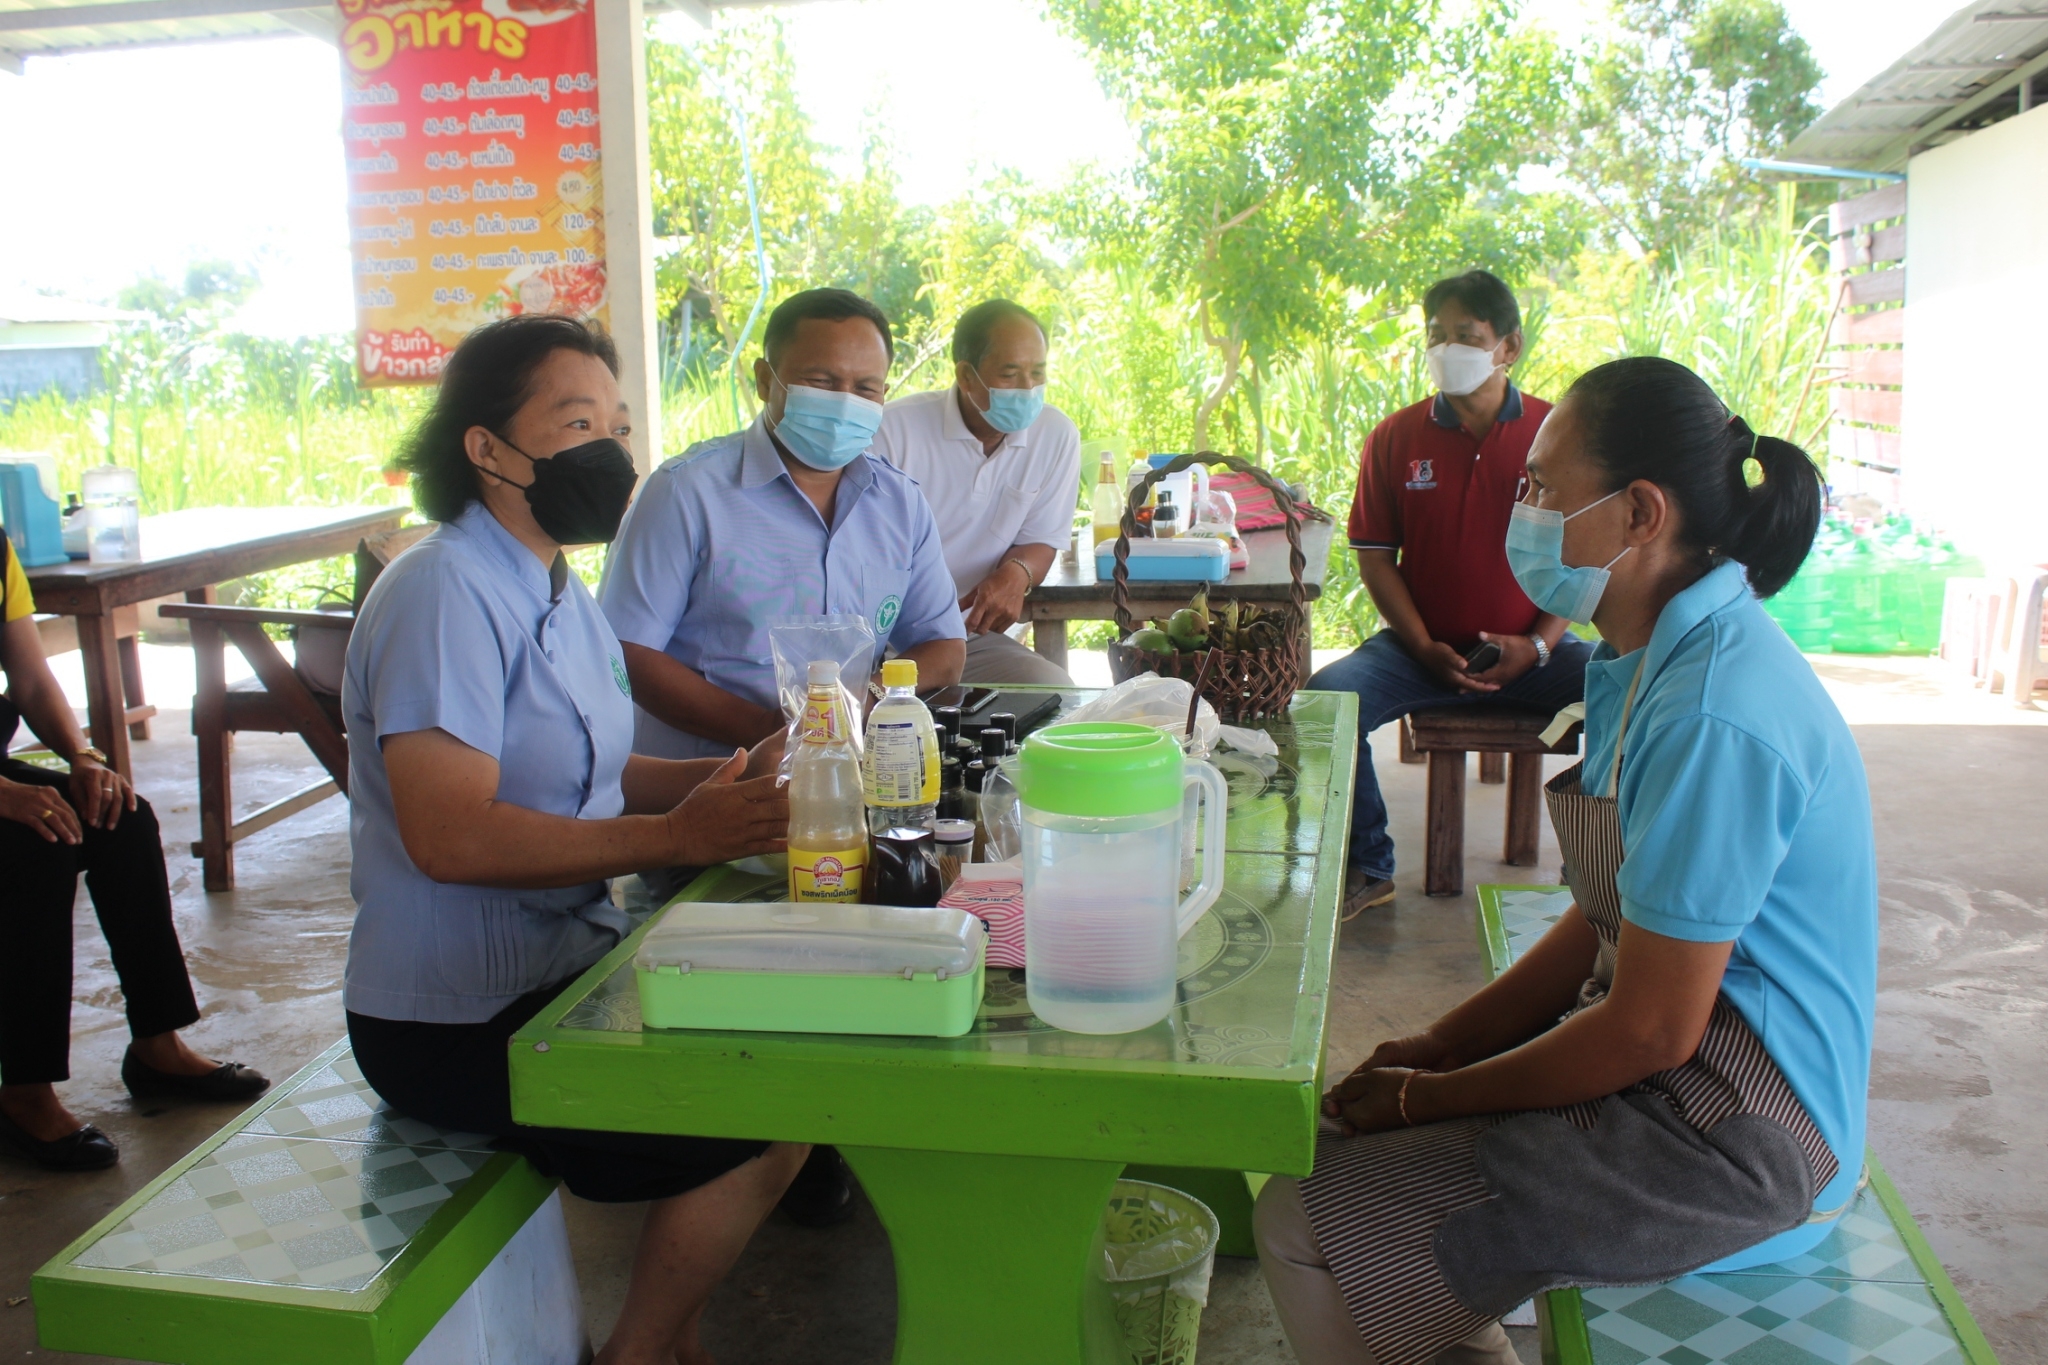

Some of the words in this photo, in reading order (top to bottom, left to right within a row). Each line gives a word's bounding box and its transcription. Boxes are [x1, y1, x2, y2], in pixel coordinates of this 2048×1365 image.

[343, 10, 529, 70] อาหาร
[469, 108, 524, 137] ต้มเลือดหมู
[471, 140, 514, 166] บะหมี่เป็ด
[510, 215, 539, 232] จานละ
[529, 249, 558, 266] จานละ
[391, 330, 430, 352] รับทำ
[362, 332, 455, 377] ข้าวกล่
